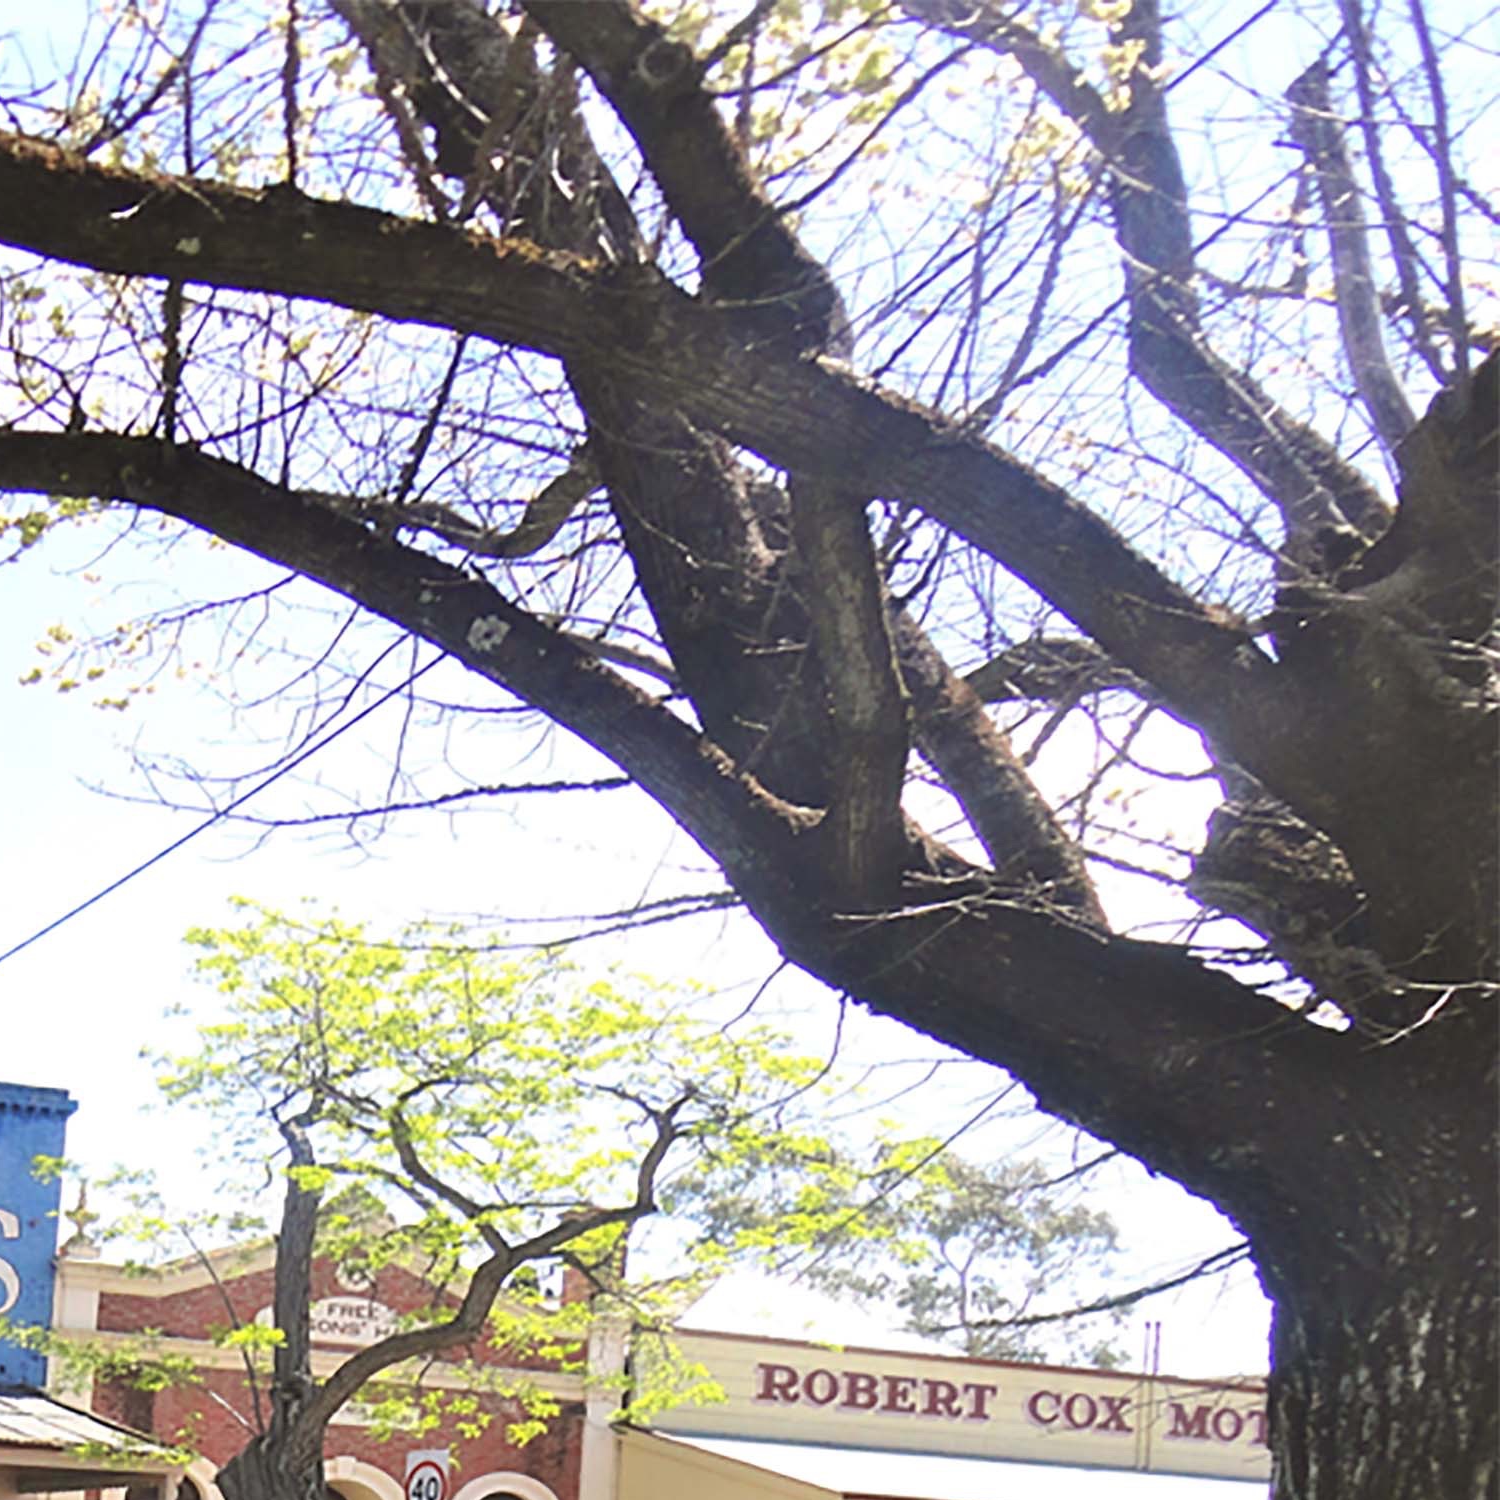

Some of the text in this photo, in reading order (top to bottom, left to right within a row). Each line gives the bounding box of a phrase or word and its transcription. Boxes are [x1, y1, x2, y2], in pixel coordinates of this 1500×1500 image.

[757, 1362, 1269, 1445] ROBERT COX MOT
